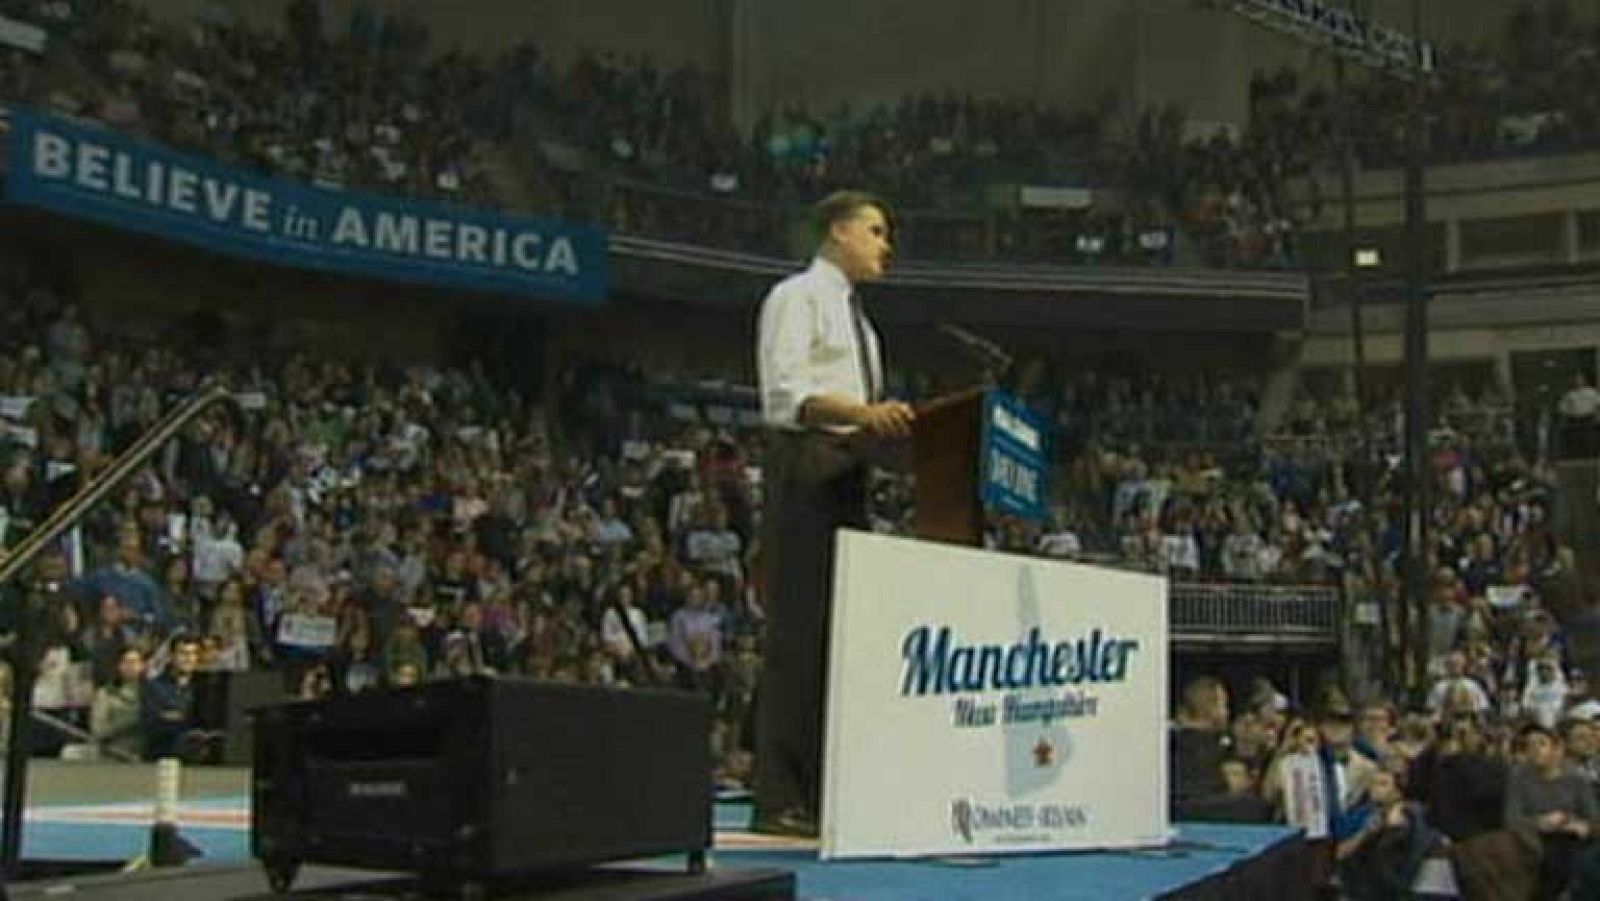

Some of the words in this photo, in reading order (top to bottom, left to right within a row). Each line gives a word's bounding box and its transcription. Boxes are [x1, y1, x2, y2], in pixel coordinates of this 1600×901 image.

[33, 131, 271, 229] BELIEVE
[283, 205, 319, 239] in
[332, 205, 579, 275] AMERICA
[902, 625, 1138, 696] Manchester
